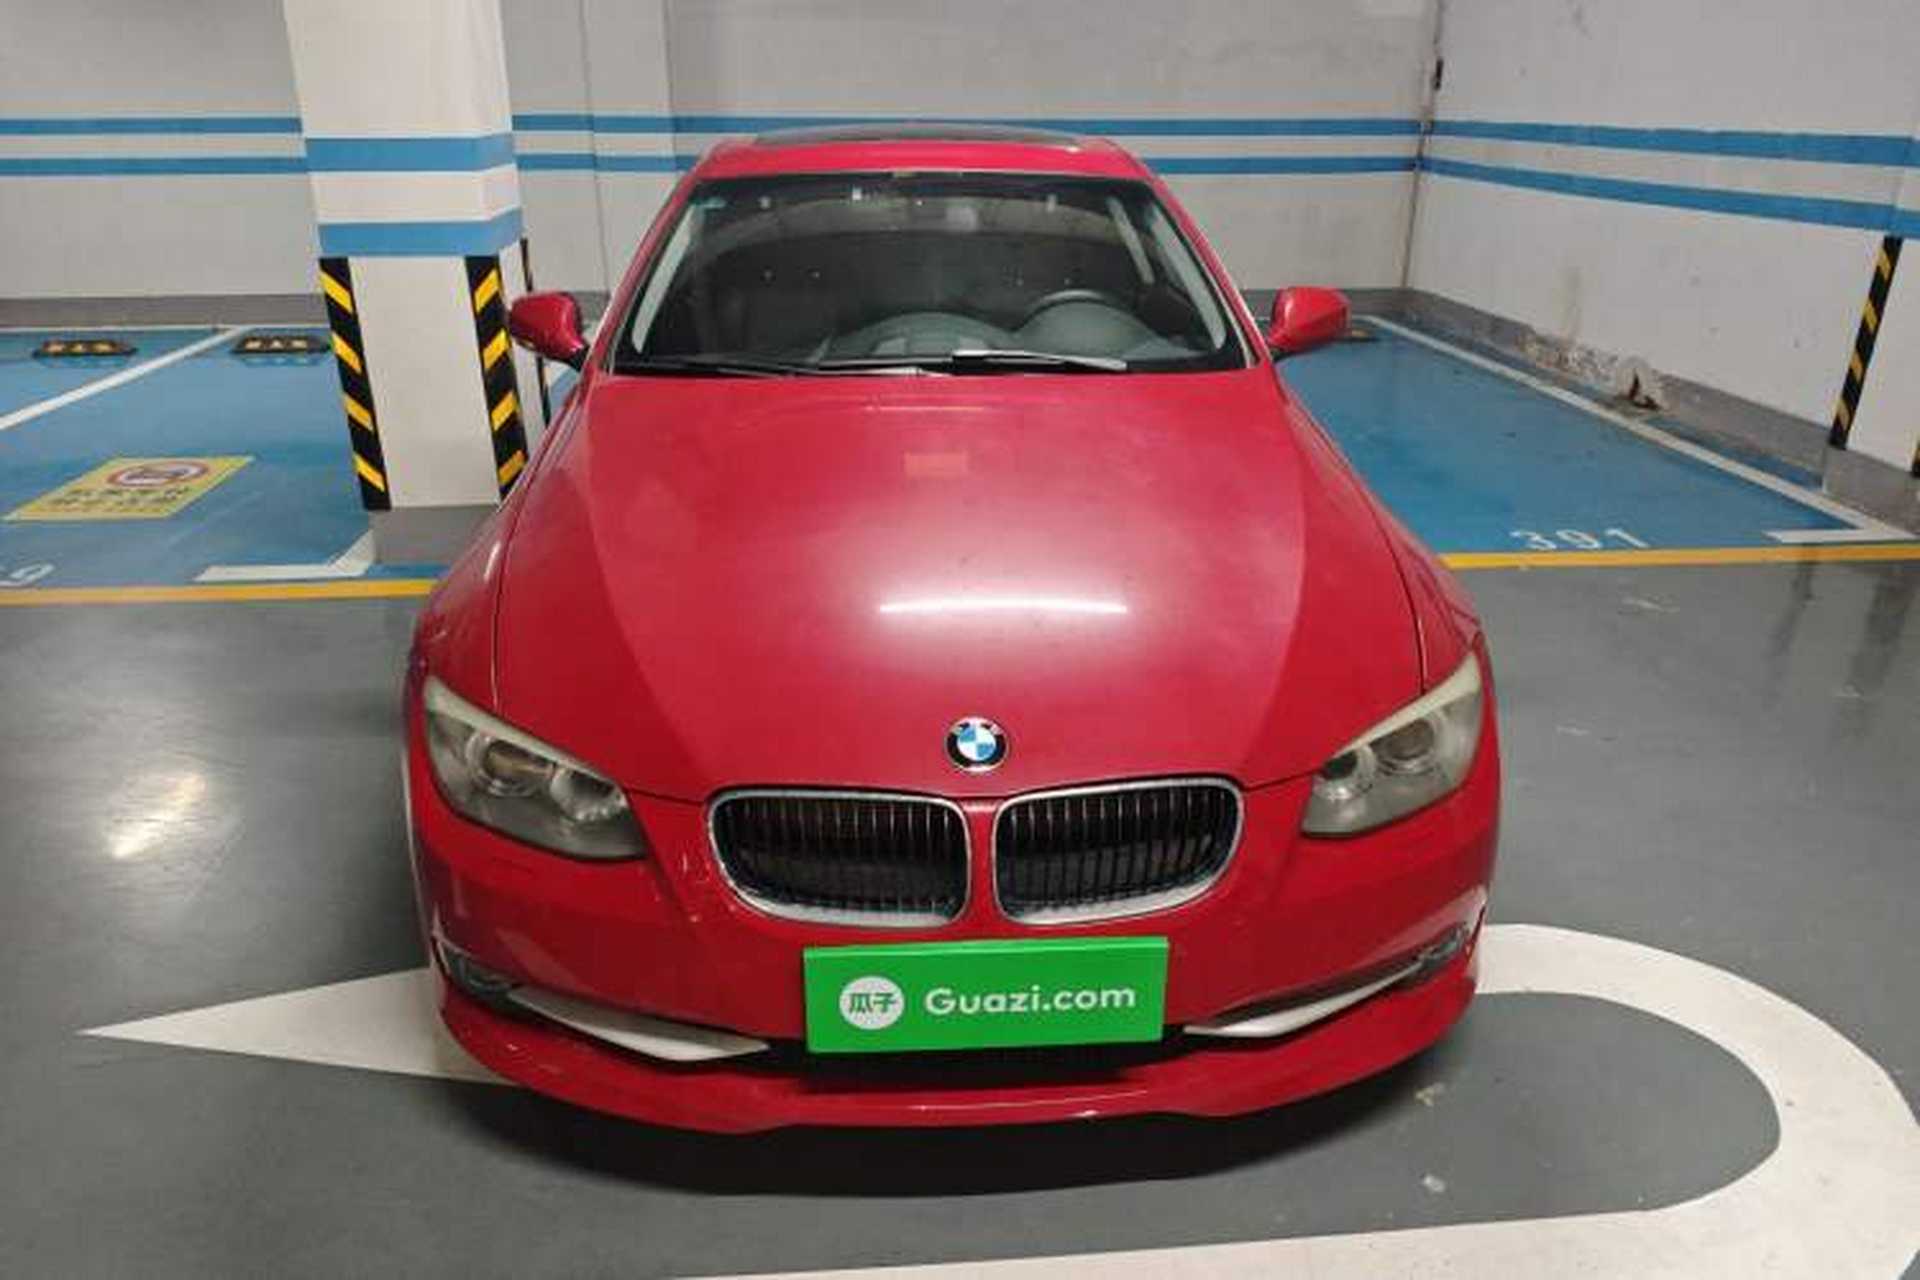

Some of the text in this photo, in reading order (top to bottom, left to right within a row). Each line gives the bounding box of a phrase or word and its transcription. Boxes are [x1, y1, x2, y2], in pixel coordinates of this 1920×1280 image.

[1510, 528, 1648, 550] 391
[849, 992, 897, 1014] 瓜子
[924, 985, 1136, 1016] Guazi.com
